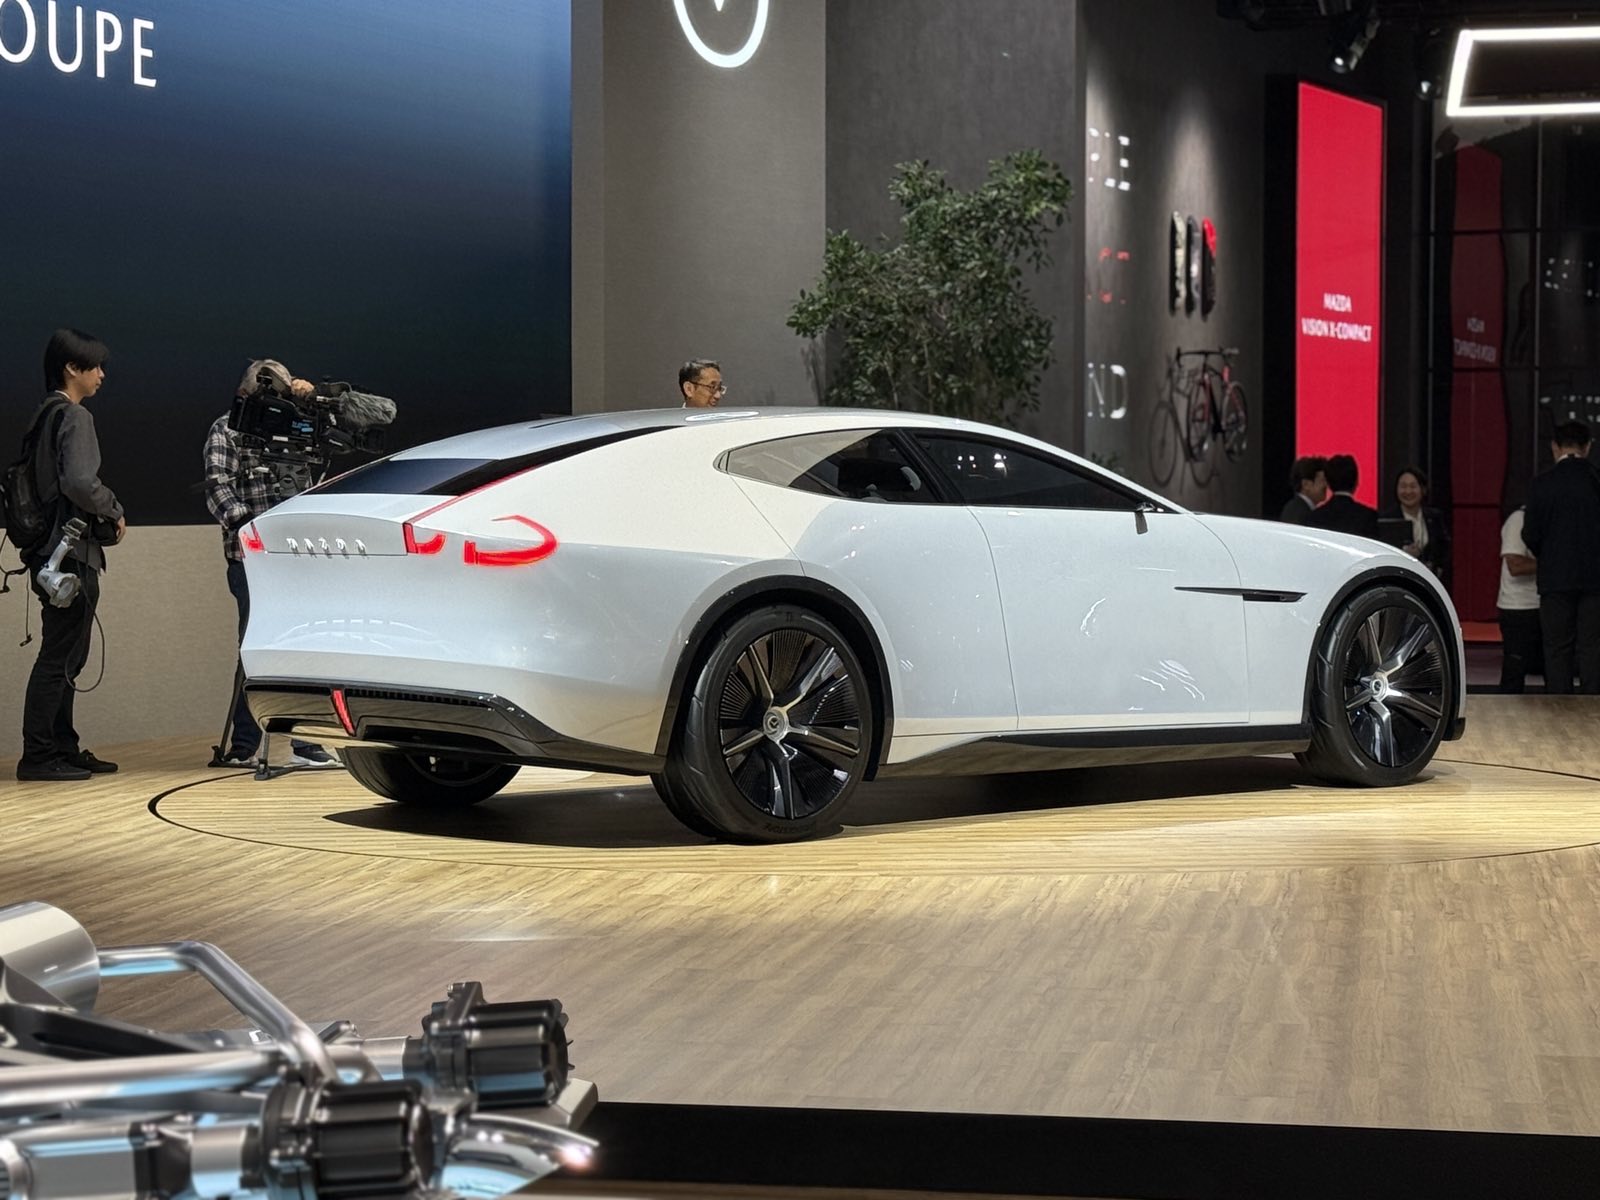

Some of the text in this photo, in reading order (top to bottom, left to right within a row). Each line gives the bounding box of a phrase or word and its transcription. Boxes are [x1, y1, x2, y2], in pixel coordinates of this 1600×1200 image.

[0, 0, 156, 87] OUPE
[1323, 293, 1352, 313] MAZDA
[1301, 317, 1329, 337] VISION
